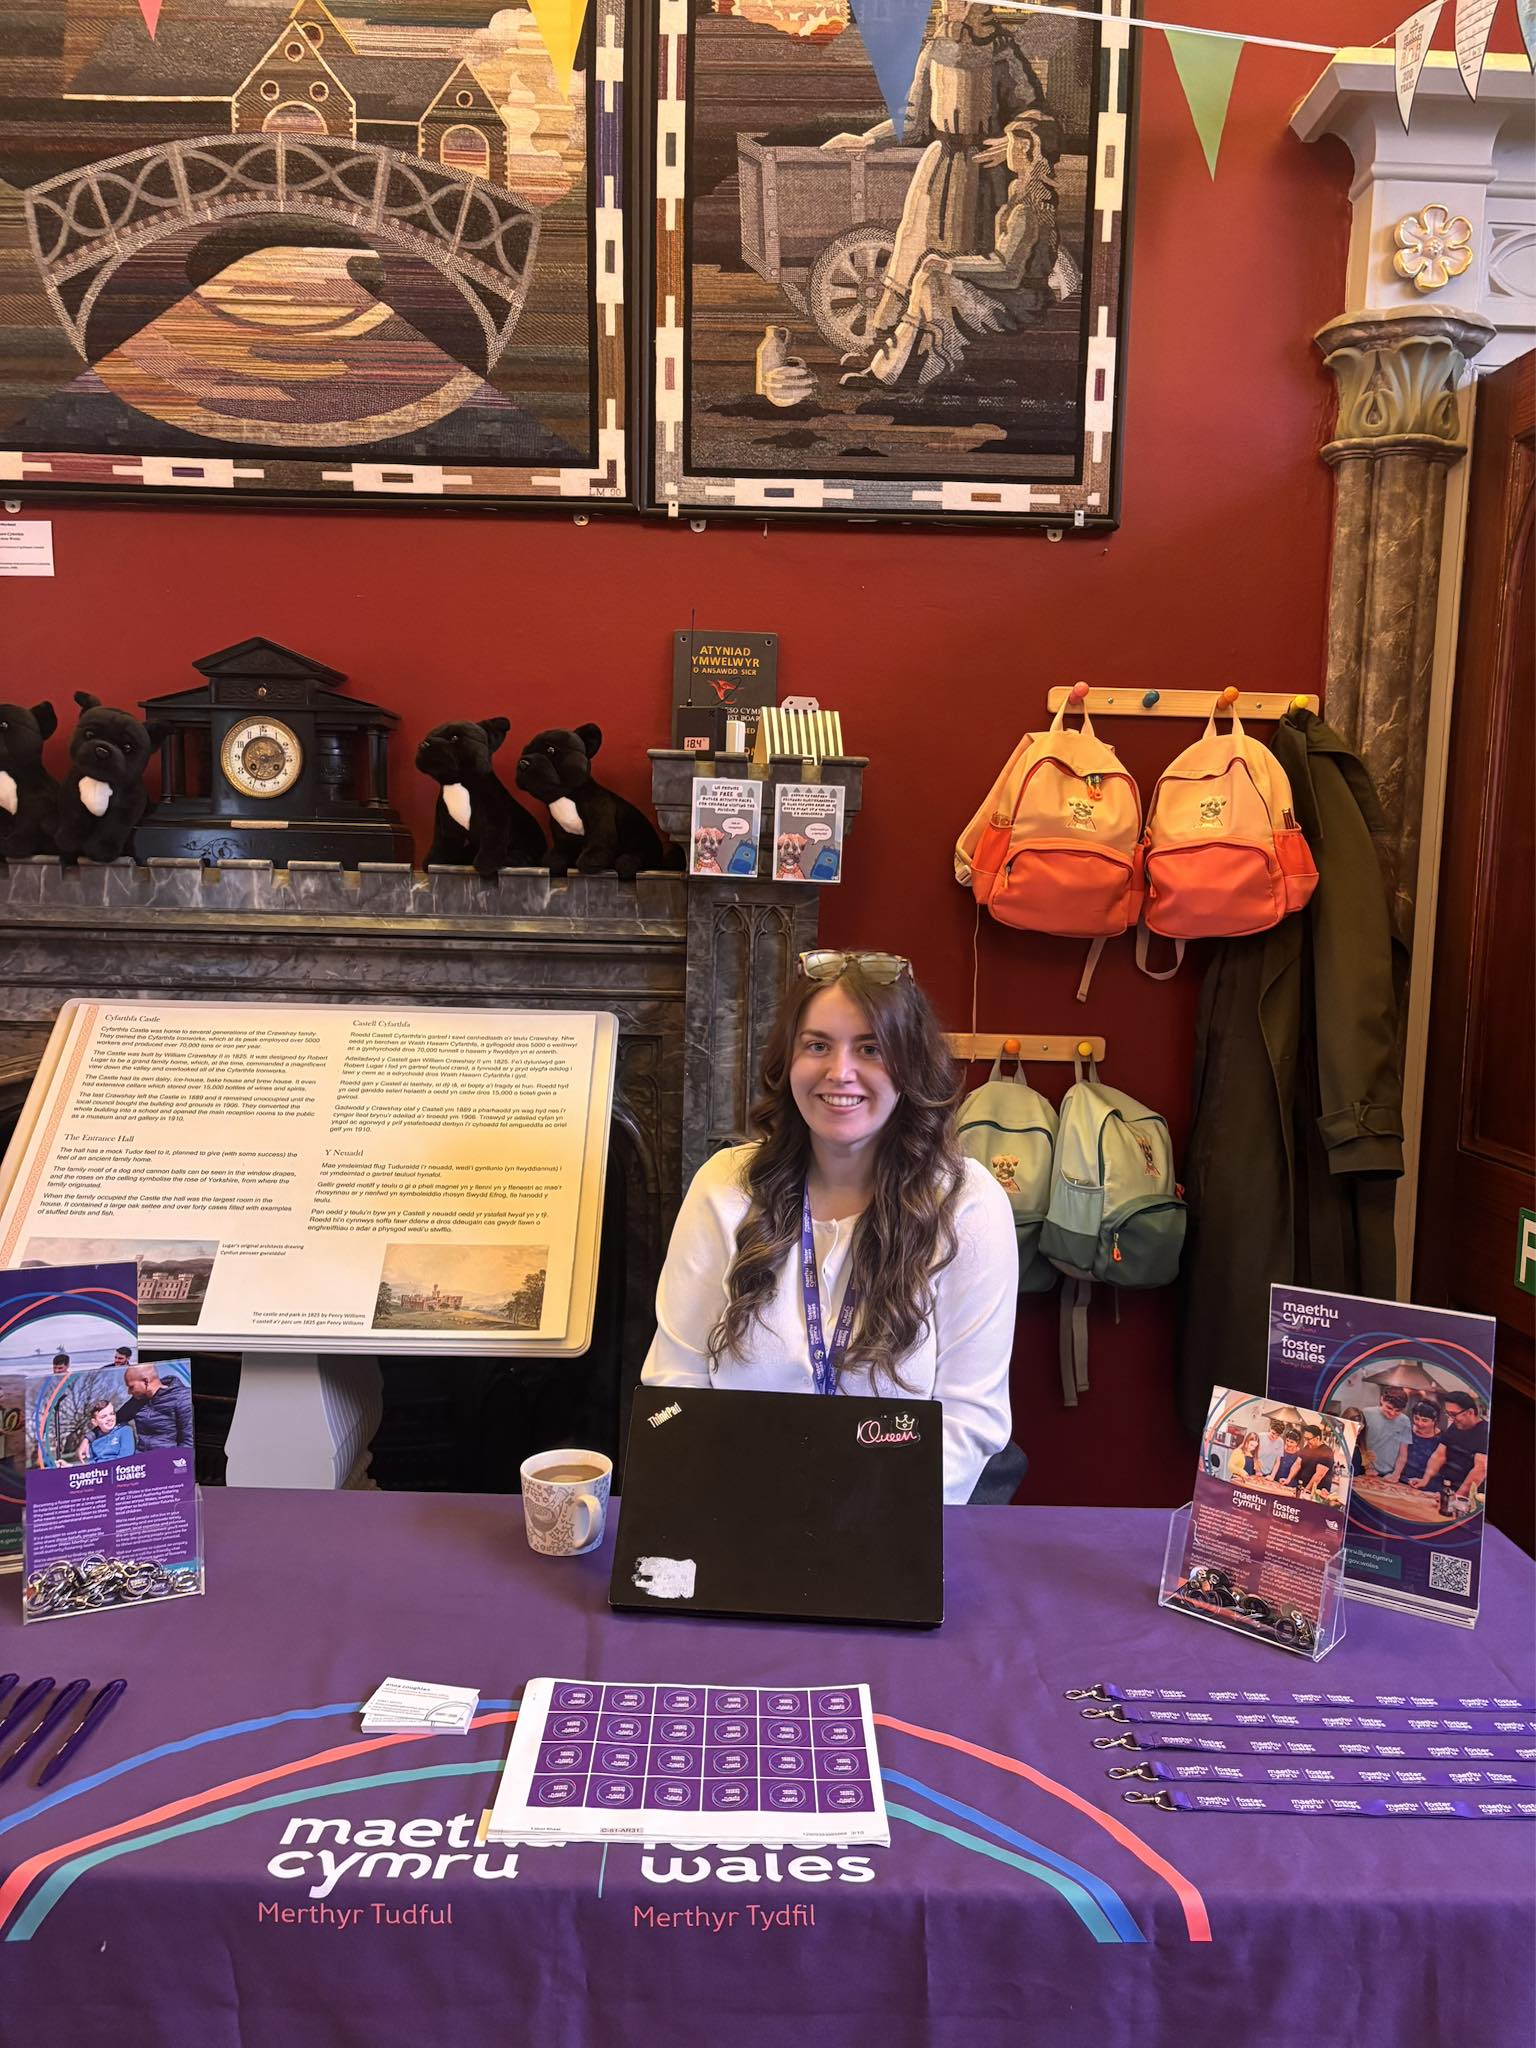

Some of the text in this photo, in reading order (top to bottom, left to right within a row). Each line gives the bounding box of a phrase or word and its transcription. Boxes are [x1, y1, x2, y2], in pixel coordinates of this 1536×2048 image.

[700, 646, 750, 656] ATYNIAD
[692, 656, 760, 668] YMWELWYR
[1283, 1302, 1338, 1319] maethu
[1283, 1312, 1330, 1328] cymru
[1282, 1336, 1326, 1353] foster
[1282, 1348, 1325, 1364] wales
[647, 1401, 682, 1428] ThinkPad
[860, 1420, 917, 1443] Queen
[69, 1464, 146, 1481] maethu foster
[69, 1478, 103, 1489] cymru
[116, 1472, 146, 1482] wales
[1232, 1497, 1261, 1511] cymru
[1272, 1510, 1300, 1523] wales
[1233, 1489, 1300, 1515] maethu foster
[279, 1812, 566, 1849] maet
[266, 1849, 876, 1899] cymru wales
[257, 1902, 453, 1930] Merthyr Tudful
[632, 1904, 816, 1932] Merthyr Tydfil
